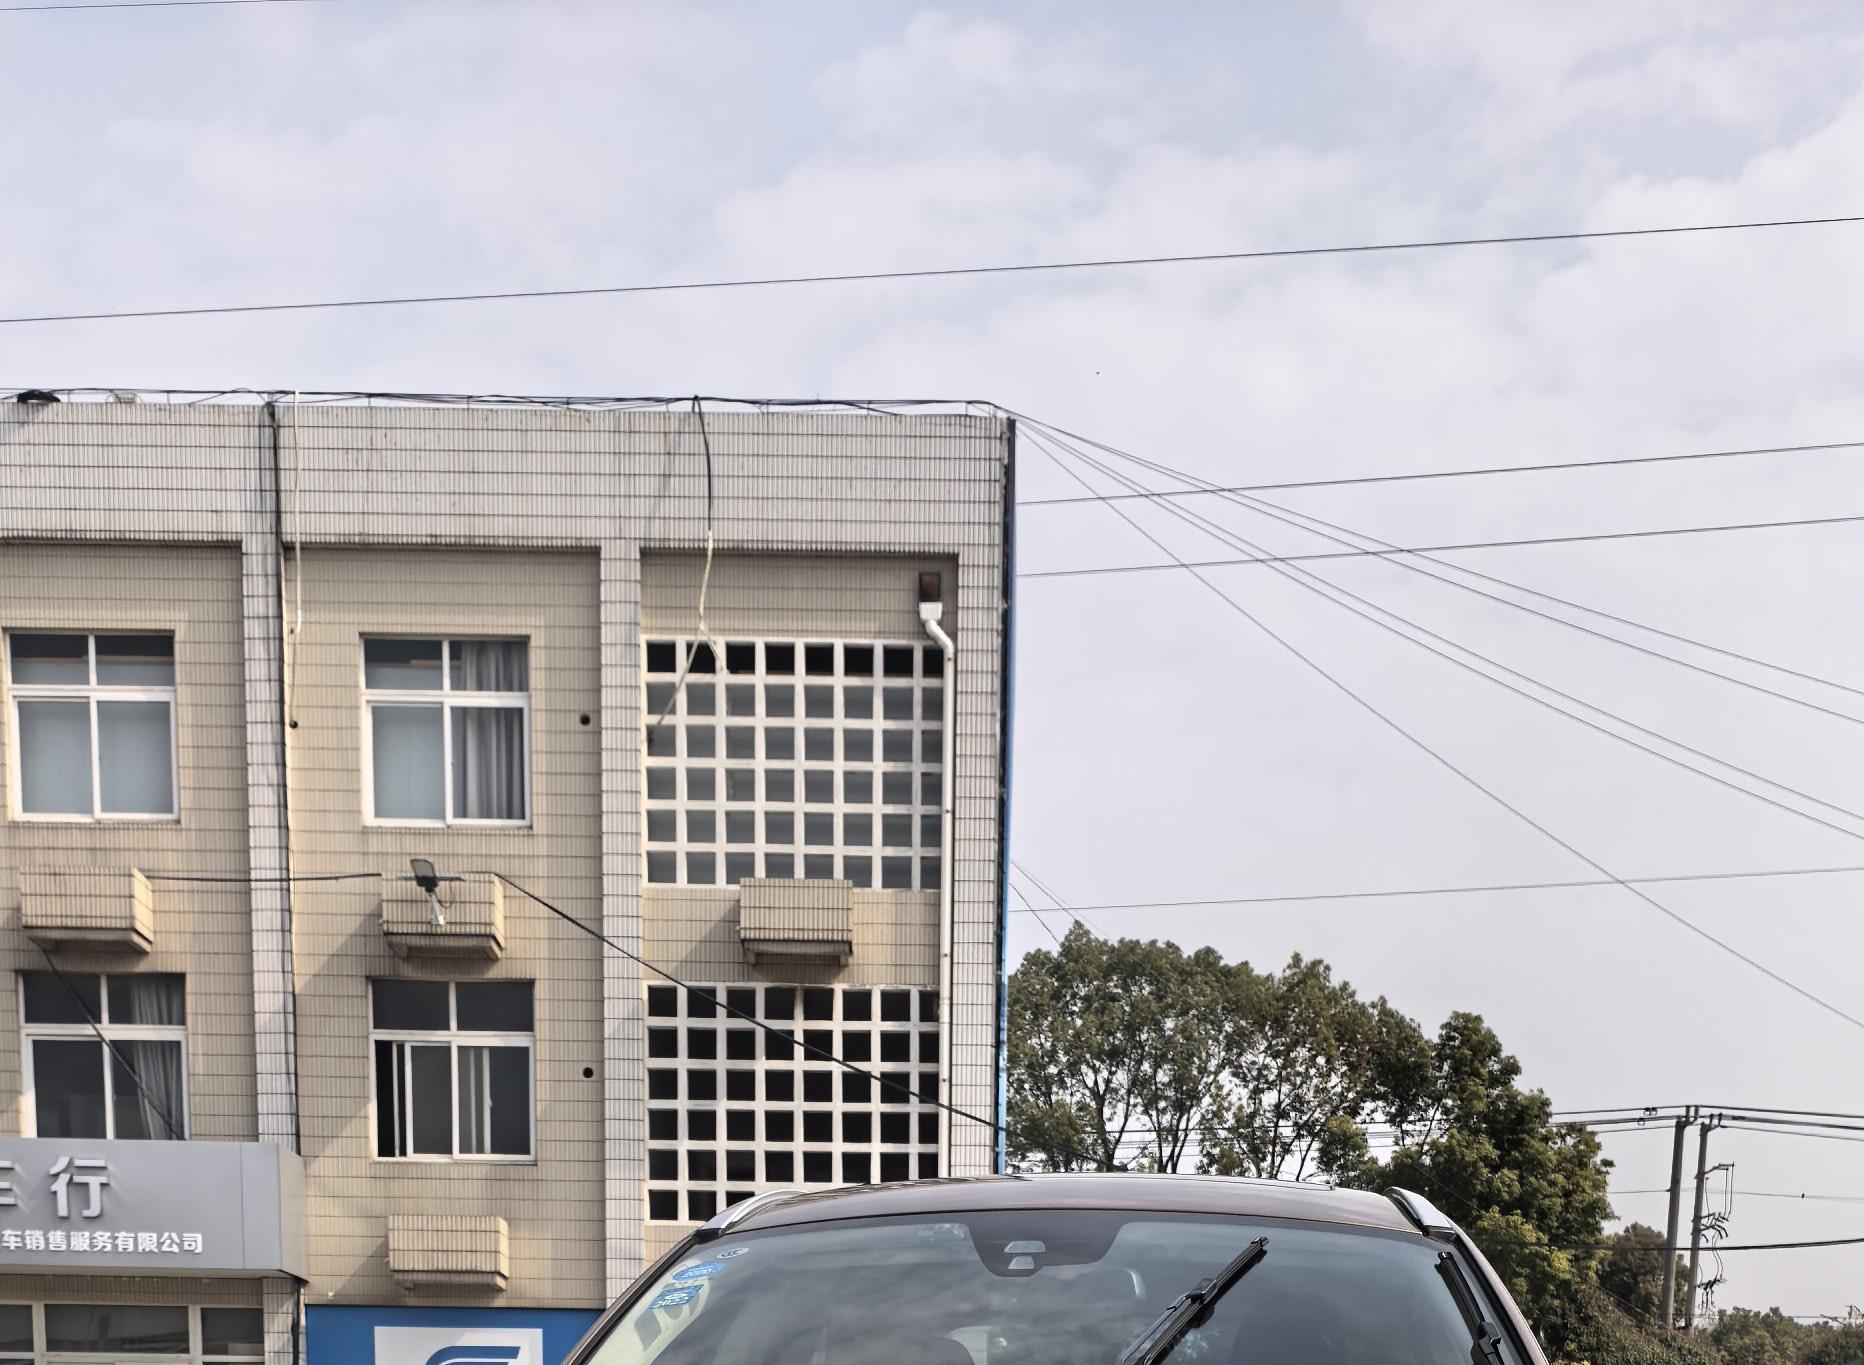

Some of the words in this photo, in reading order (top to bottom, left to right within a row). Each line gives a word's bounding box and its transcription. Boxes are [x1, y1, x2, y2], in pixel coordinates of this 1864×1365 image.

[1, 1229, 203, 1253] 车销售服务有限公司
